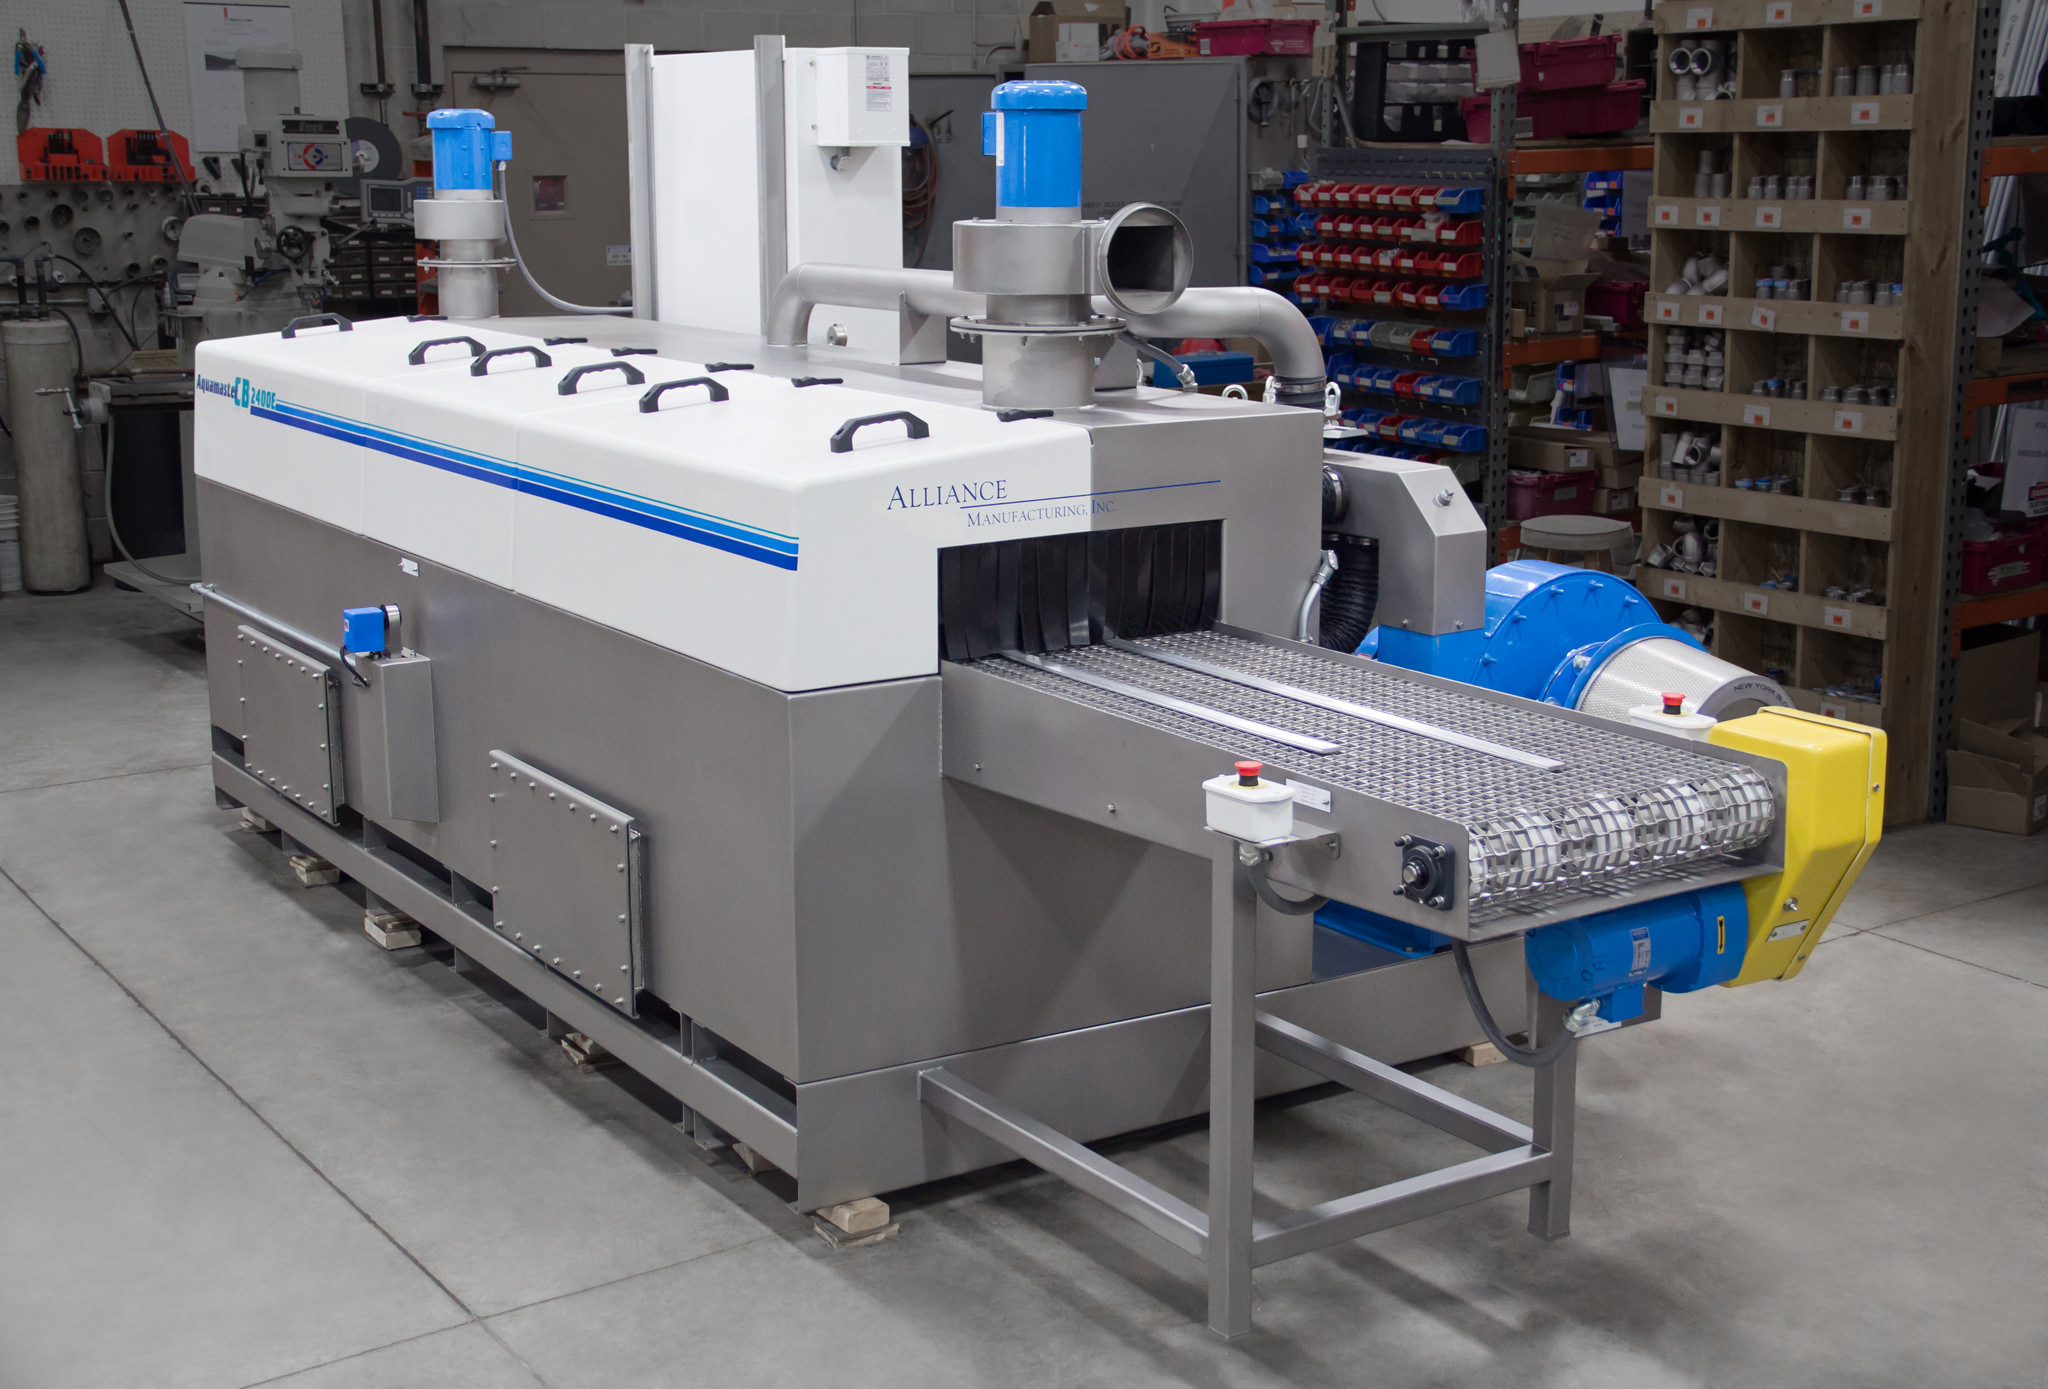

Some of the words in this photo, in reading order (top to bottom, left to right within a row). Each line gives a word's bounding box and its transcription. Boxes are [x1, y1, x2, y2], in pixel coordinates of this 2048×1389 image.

[234, 376, 250, 409] CB
[251, 387, 277, 410] 2400E
[887, 479, 1008, 510] ALLIANCE
[967, 504, 1088, 528] MANUFACTURING,
[1091, 499, 1117, 515] INC.
[1733, 682, 1753, 692] NEW
[1755, 682, 1776, 696] YORK
